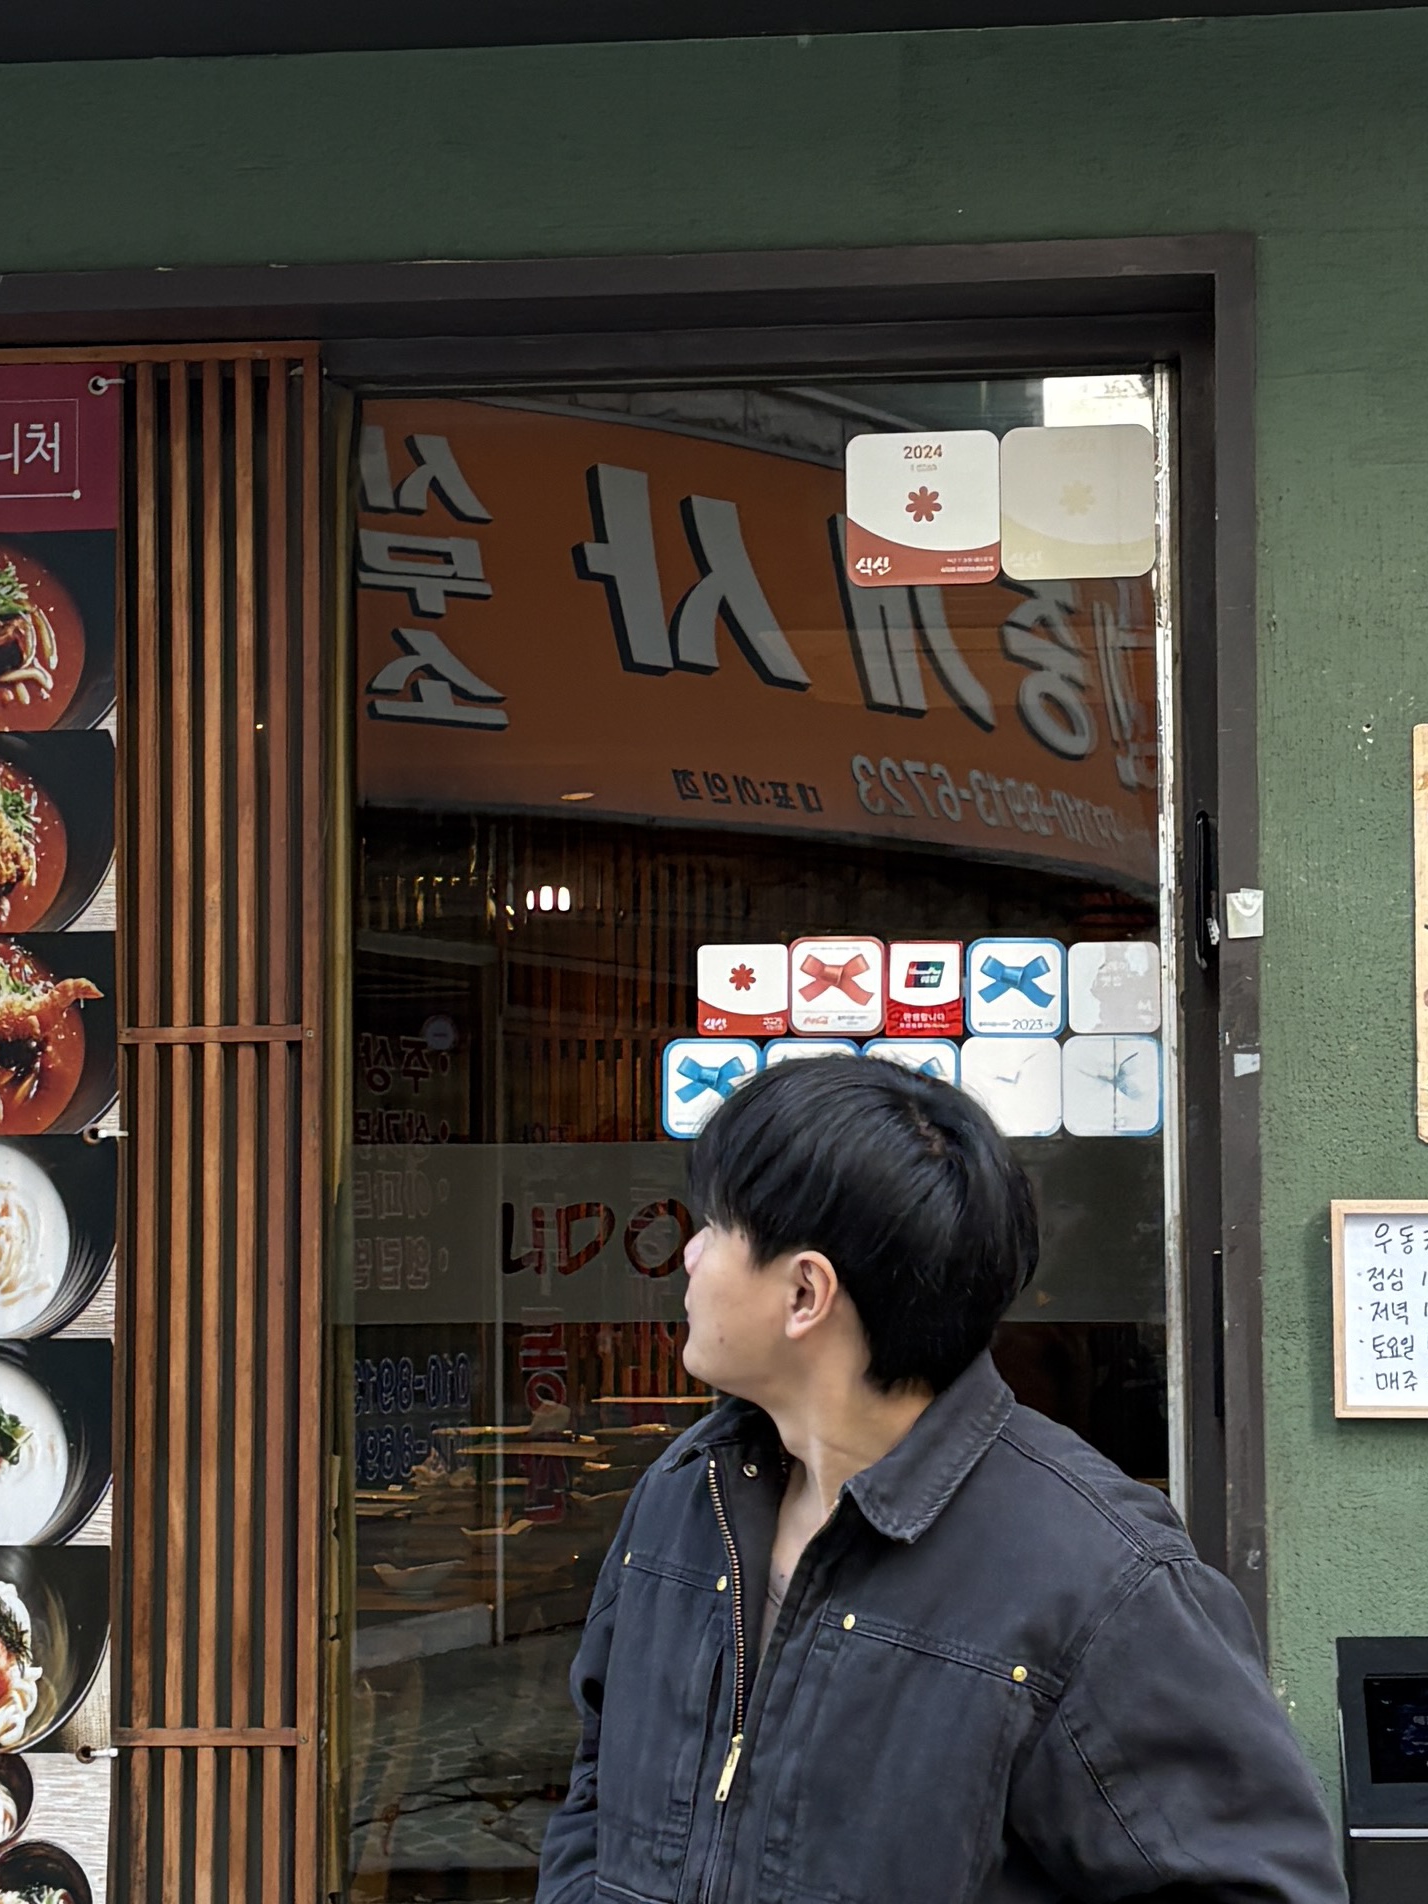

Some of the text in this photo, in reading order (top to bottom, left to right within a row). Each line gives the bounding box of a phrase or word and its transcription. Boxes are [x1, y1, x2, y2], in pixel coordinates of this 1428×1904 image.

[903, 443, 943, 460] 2024
[1012, 1018, 1043, 1031] 2023
[1366, 1266, 1404, 1292] 점심
[1370, 1300, 1409, 1325] 저녁
[1372, 1334, 1415, 1360] 토요일
[1375, 1370, 1419, 1392] 매주
